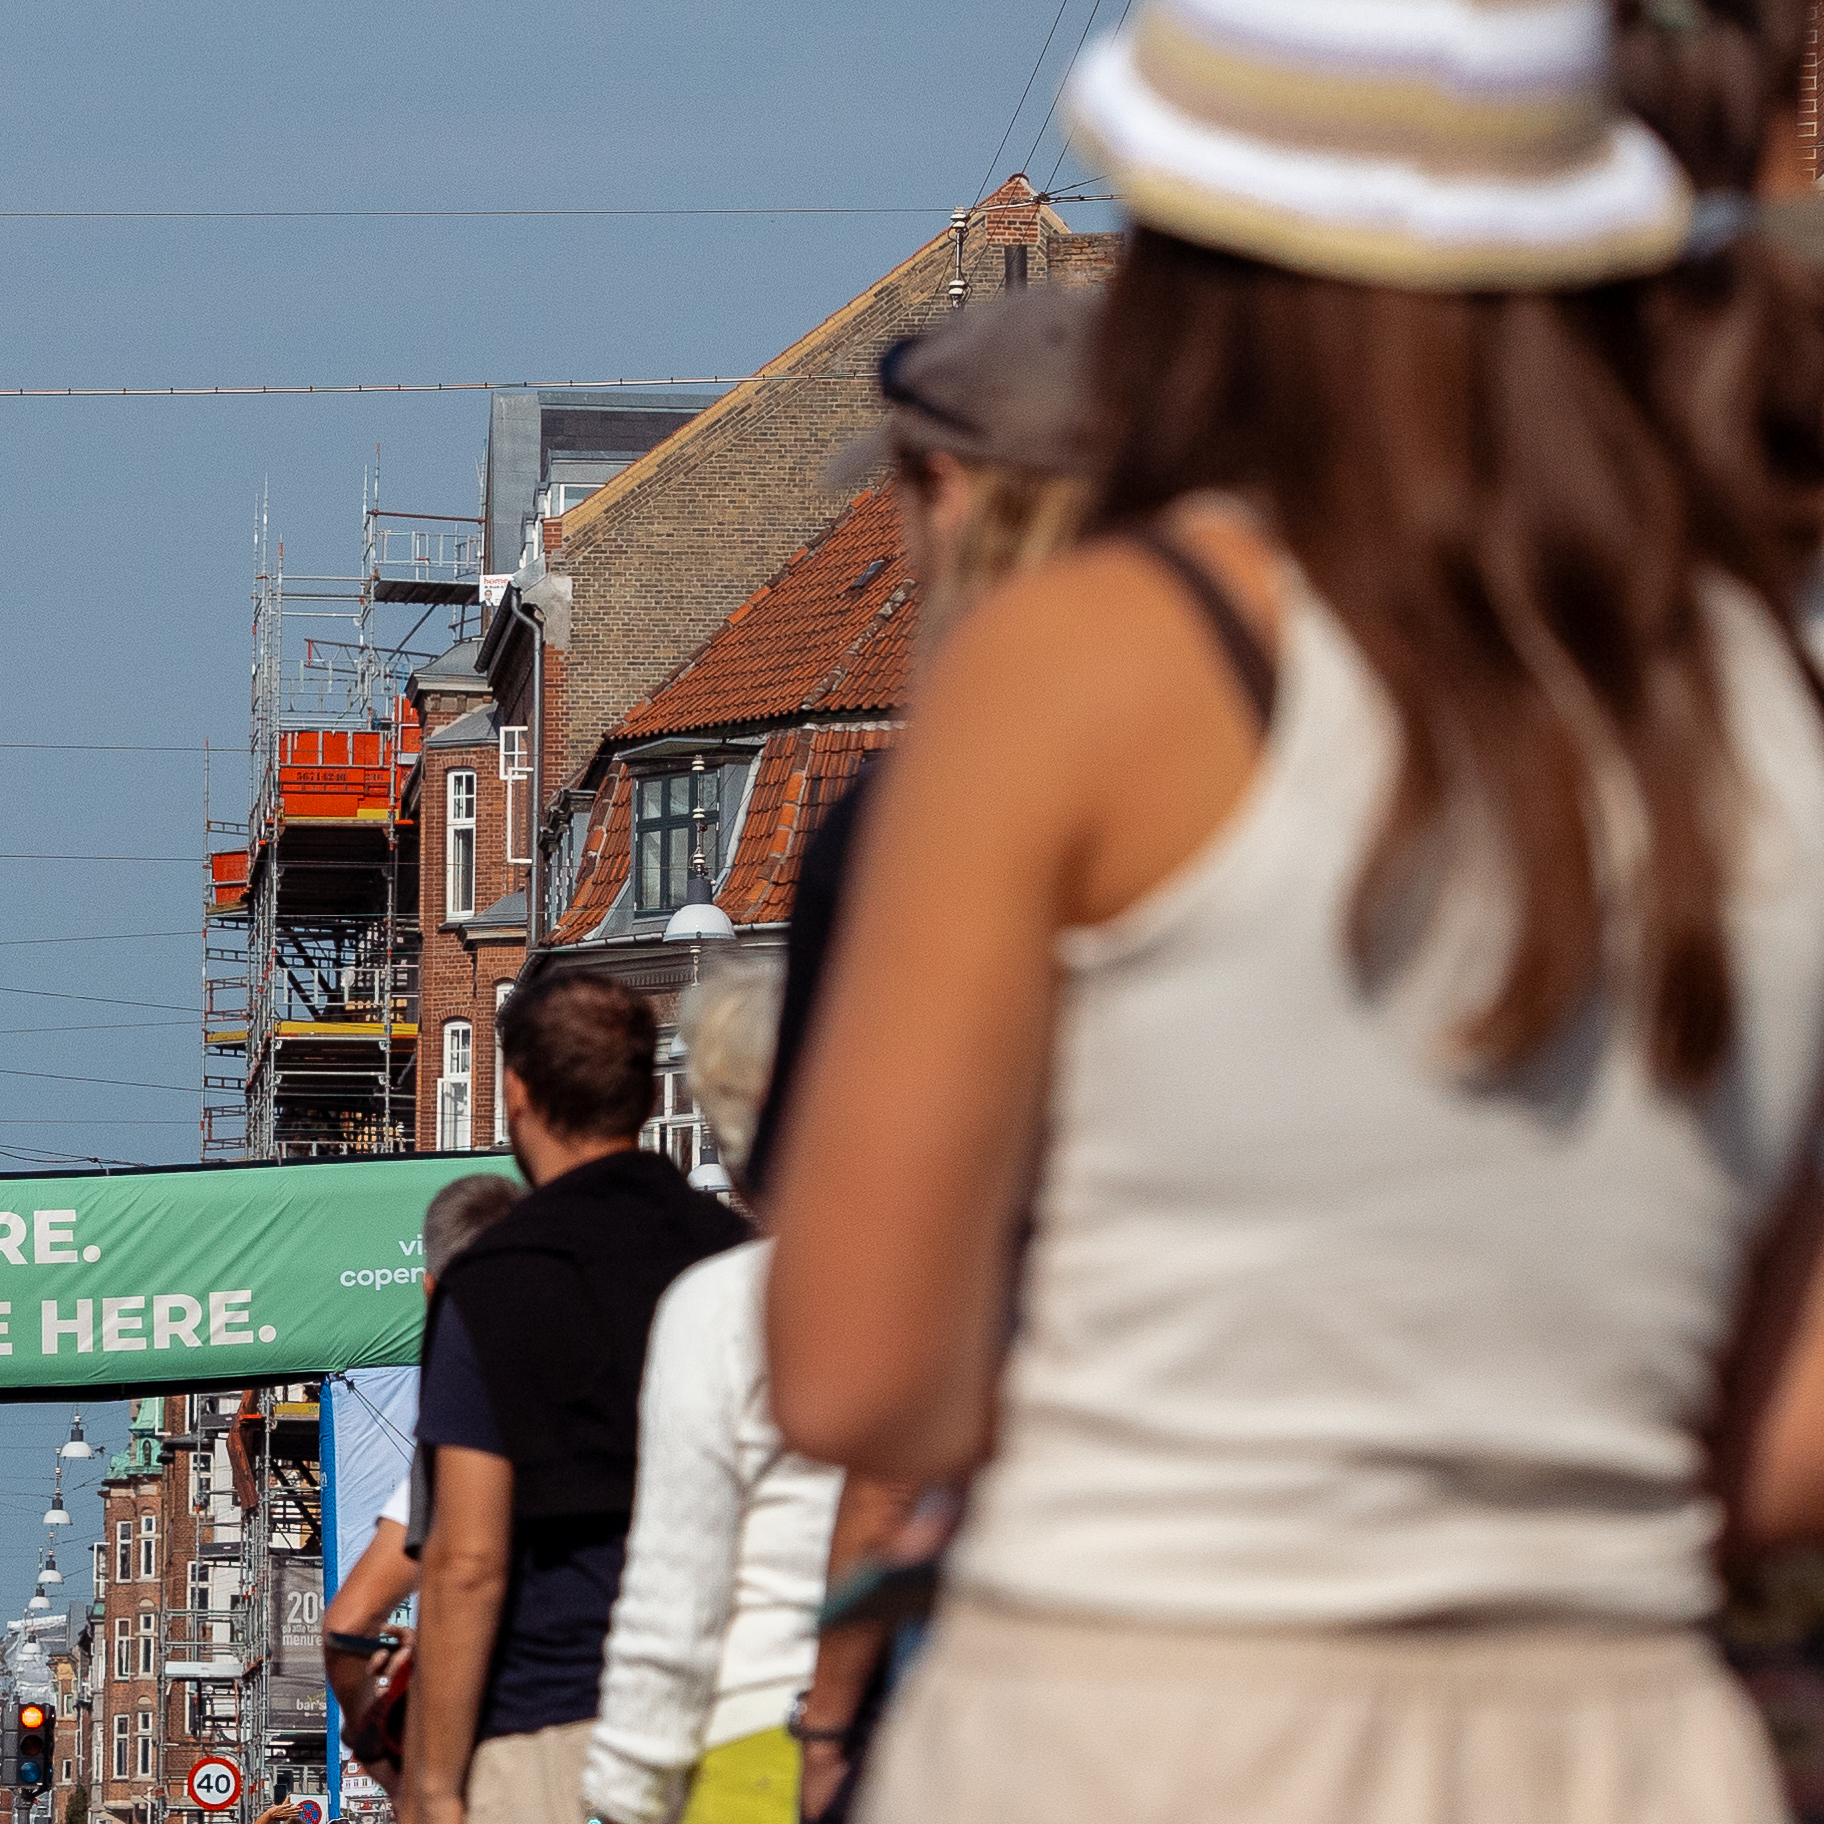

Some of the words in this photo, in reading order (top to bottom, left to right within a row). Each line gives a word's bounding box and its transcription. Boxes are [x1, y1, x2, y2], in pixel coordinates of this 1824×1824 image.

[339, 1266, 427, 1292] copen
[41, 1289, 278, 1356] HERE.
[287, 1591, 325, 1624] 20
[196, 1773, 231, 1794] 40
